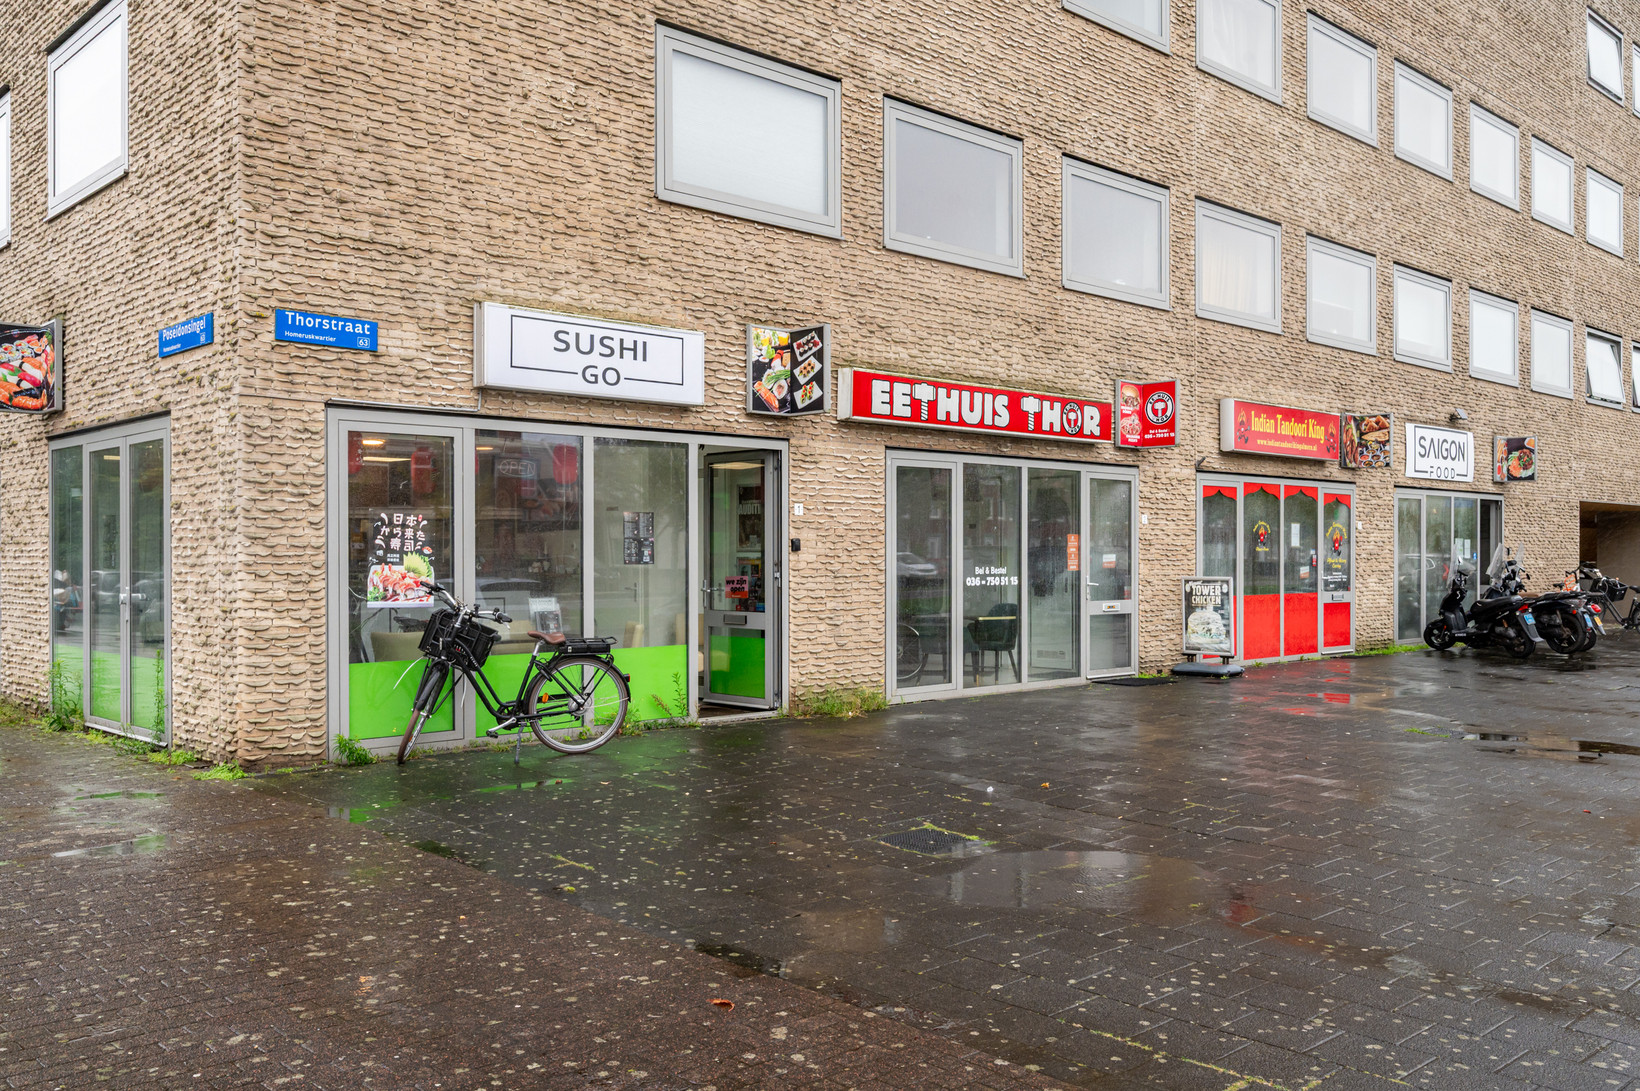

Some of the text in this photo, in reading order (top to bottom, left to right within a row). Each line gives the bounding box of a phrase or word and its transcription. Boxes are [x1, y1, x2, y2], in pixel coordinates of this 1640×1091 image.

[163, 316, 206, 341] Poseidonsingel
[285, 311, 370, 335] Thorstraat
[284, 330, 337, 342] Homeruskwartier
[358, 339, 369, 347] 63
[553, 329, 648, 362] SUSHI
[581, 365, 621, 386] GO
[871, 379, 1010, 428] EETHUIS
[1020, 395, 1101, 437] THOR
[1251, 410, 1325, 444] Indian Tandoori King
[1418, 435, 1466, 462] SAIGON
[500, 460, 536, 475] OPEN
[1429, 465, 1456, 480] FOOD
[393, 513, 418, 527] 日本
[974, 566, 985, 575] Bel
[985, 566, 990, 575] &
[736, 577, 747, 587] zijn
[966, 576, 981, 587] 036
[1000, 576, 1009, 586] 51
[1010, 576, 1019, 586] 15
[1191, 584, 1222, 596] TOWER
[1191, 595, 1222, 605] CHICKEN
